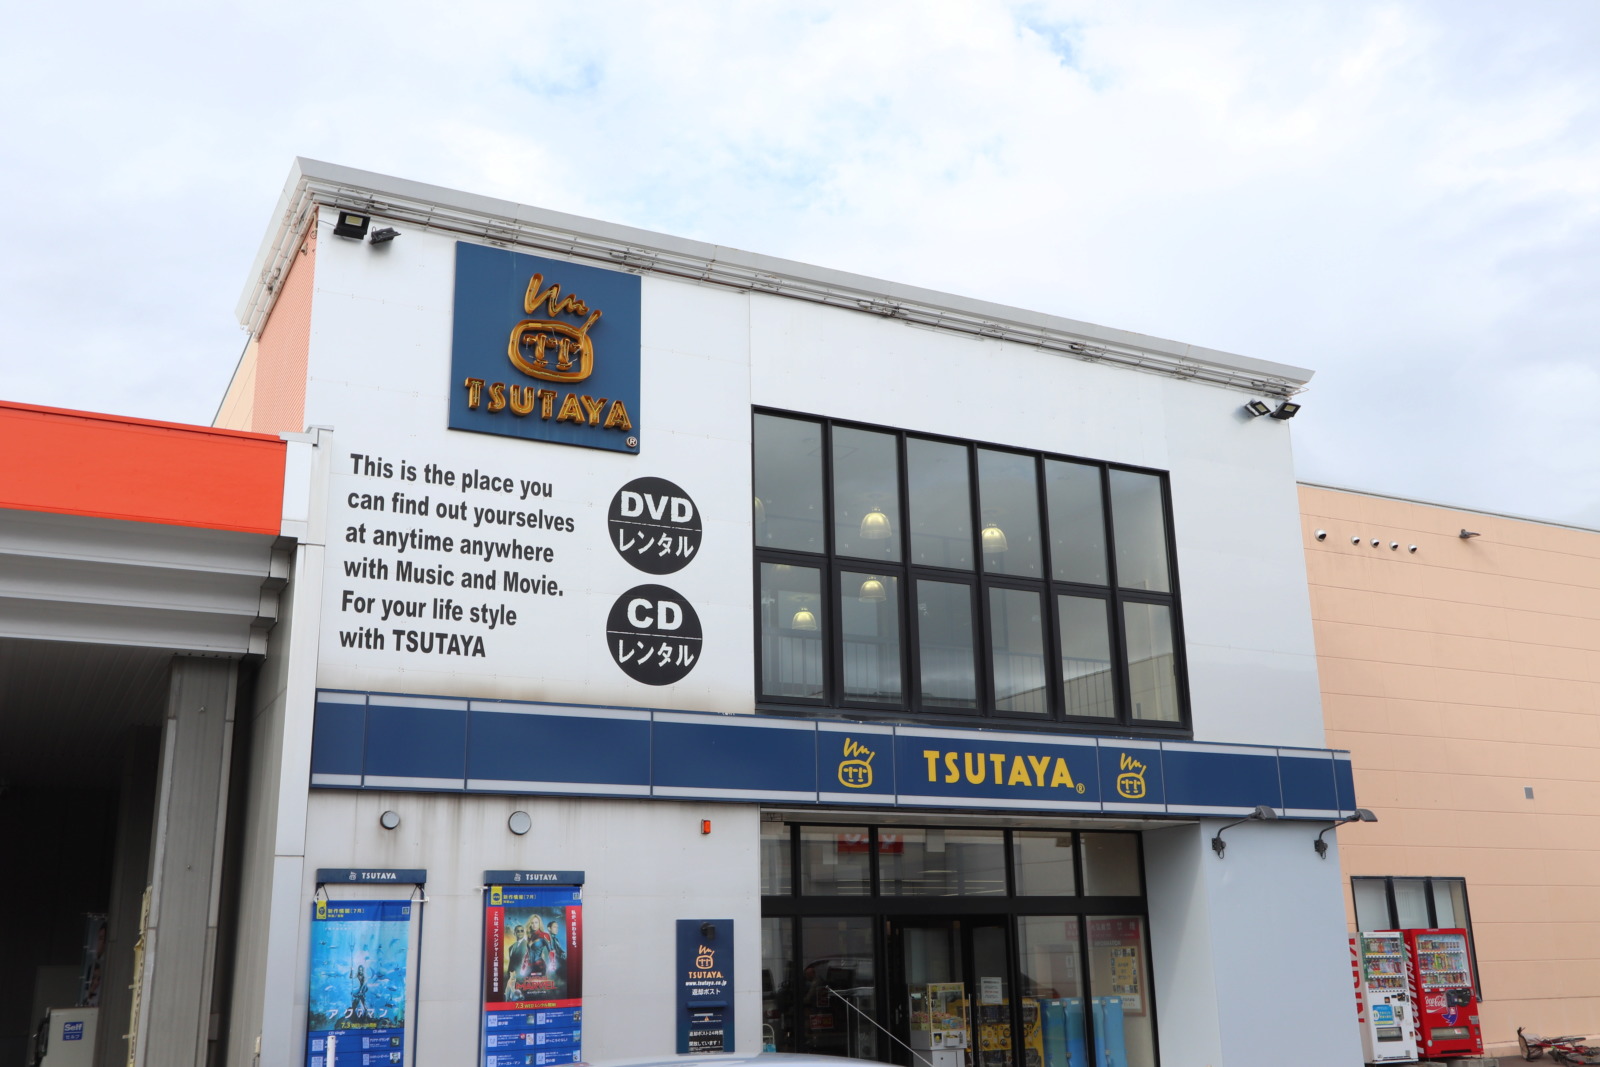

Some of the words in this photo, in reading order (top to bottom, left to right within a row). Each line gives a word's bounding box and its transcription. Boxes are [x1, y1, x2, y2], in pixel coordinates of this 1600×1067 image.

[464, 376, 633, 431] TSUTAYA
[351, 454, 393, 478] This
[401, 460, 416, 481] is
[424, 464, 455, 486] the
[462, 469, 513, 493] place
[520, 480, 552, 500] you
[348, 493, 384, 511] can
[392, 492, 429, 516] find
[436, 502, 467, 520] out
[474, 507, 574, 532] yourselves
[620, 490, 694, 524] DVD
[346, 524, 366, 543] at
[373, 529, 453, 553] anytime
[460, 539, 553, 562] anywhere
[619, 528, 695, 559] レンタル
[344, 557, 388, 580] with
[396, 561, 454, 586] Music
[461, 570, 496, 590] and
[504, 571, 563, 596] Movie.
[342, 590, 375, 613] For
[381, 599, 426, 621] your
[433, 598, 463, 621] life
[470, 604, 516, 629] style
[626, 598, 683, 631] CD
[340, 627, 384, 650] with
[393, 630, 485, 657] TSUTAYA
[618, 637, 695, 668] レンタル
[923, 750, 1075, 789] TSUTAYA
[64, 1024, 82, 1032] Self
